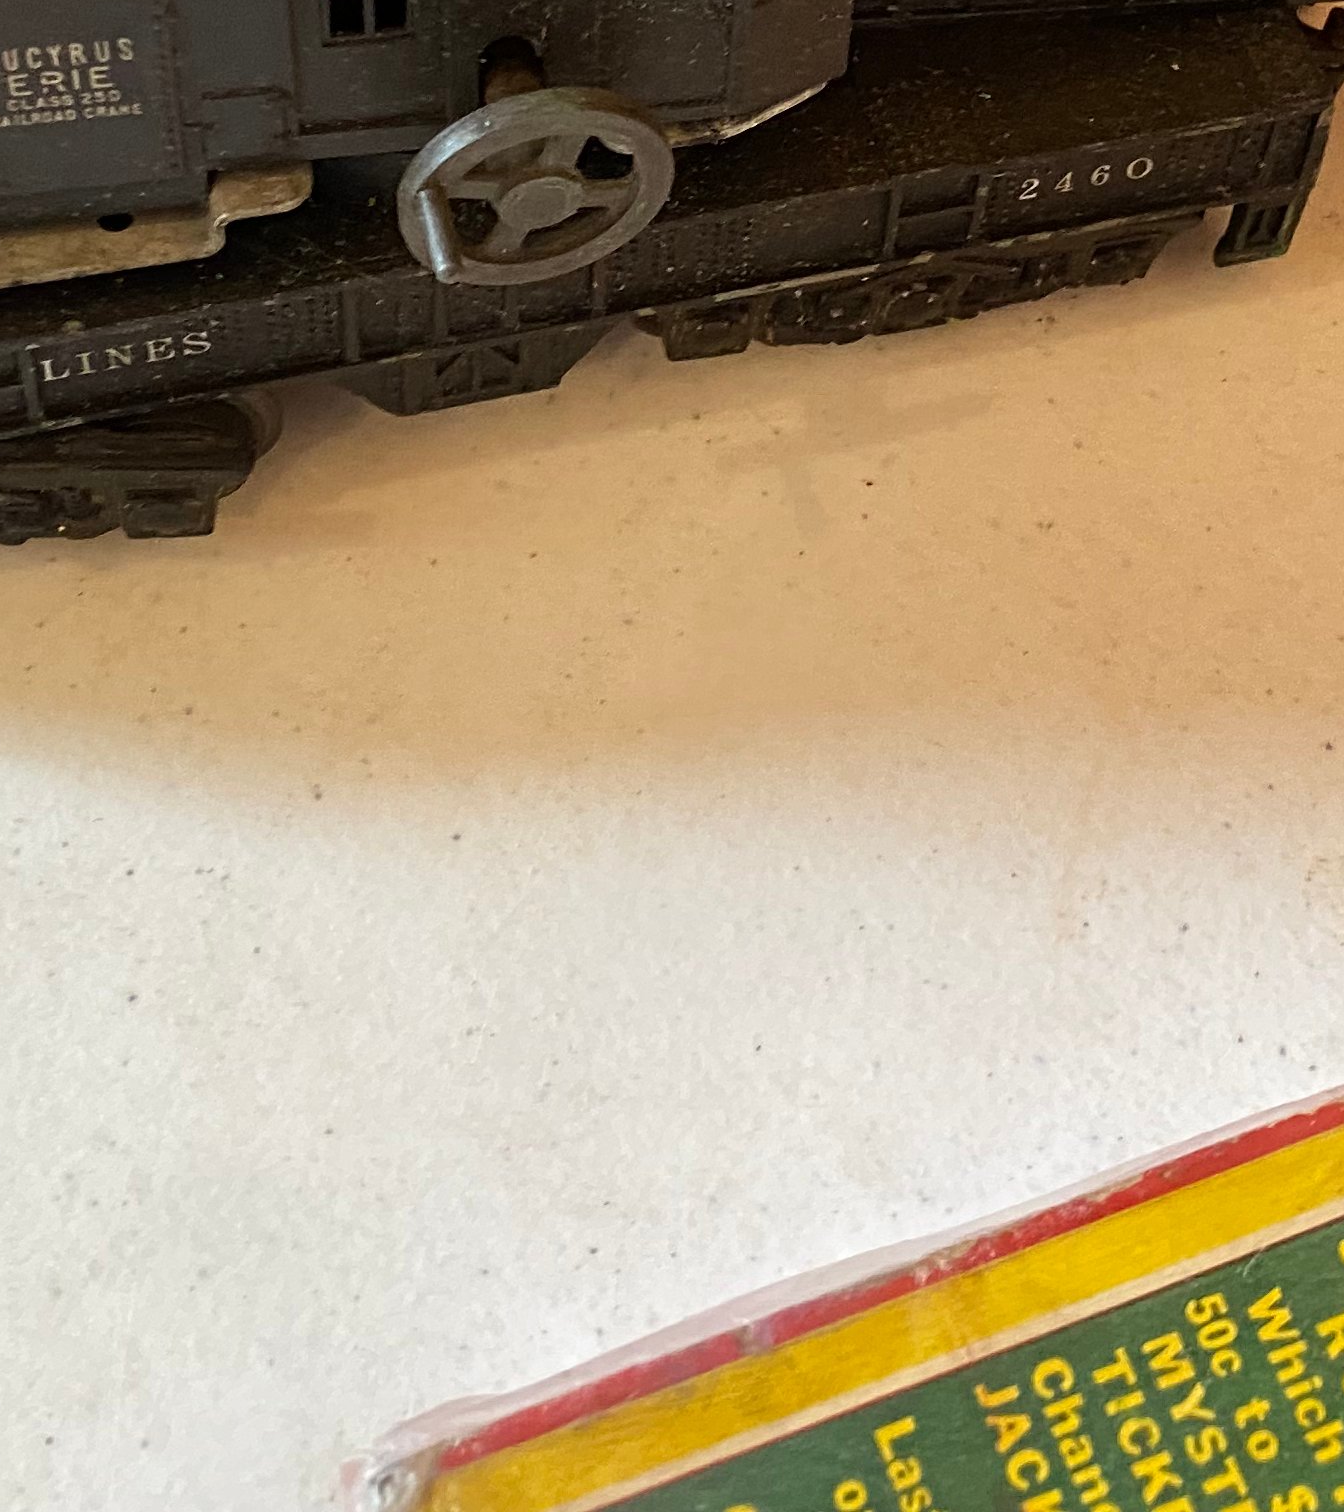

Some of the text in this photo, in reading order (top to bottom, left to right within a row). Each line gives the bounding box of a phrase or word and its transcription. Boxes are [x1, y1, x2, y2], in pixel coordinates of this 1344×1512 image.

[6, 93, 76, 112] CLASS
[7, 65, 116, 97] ERIE
[1018, 156, 1155, 201] 2460
[39, 330, 213, 383] LINES
[1031, 1356, 1120, 1512] Chan
[1142, 1331, 1256, 1512] MYST
[1234, 1397, 1280, 1463] to
[874, 1415, 940, 1512] Las
